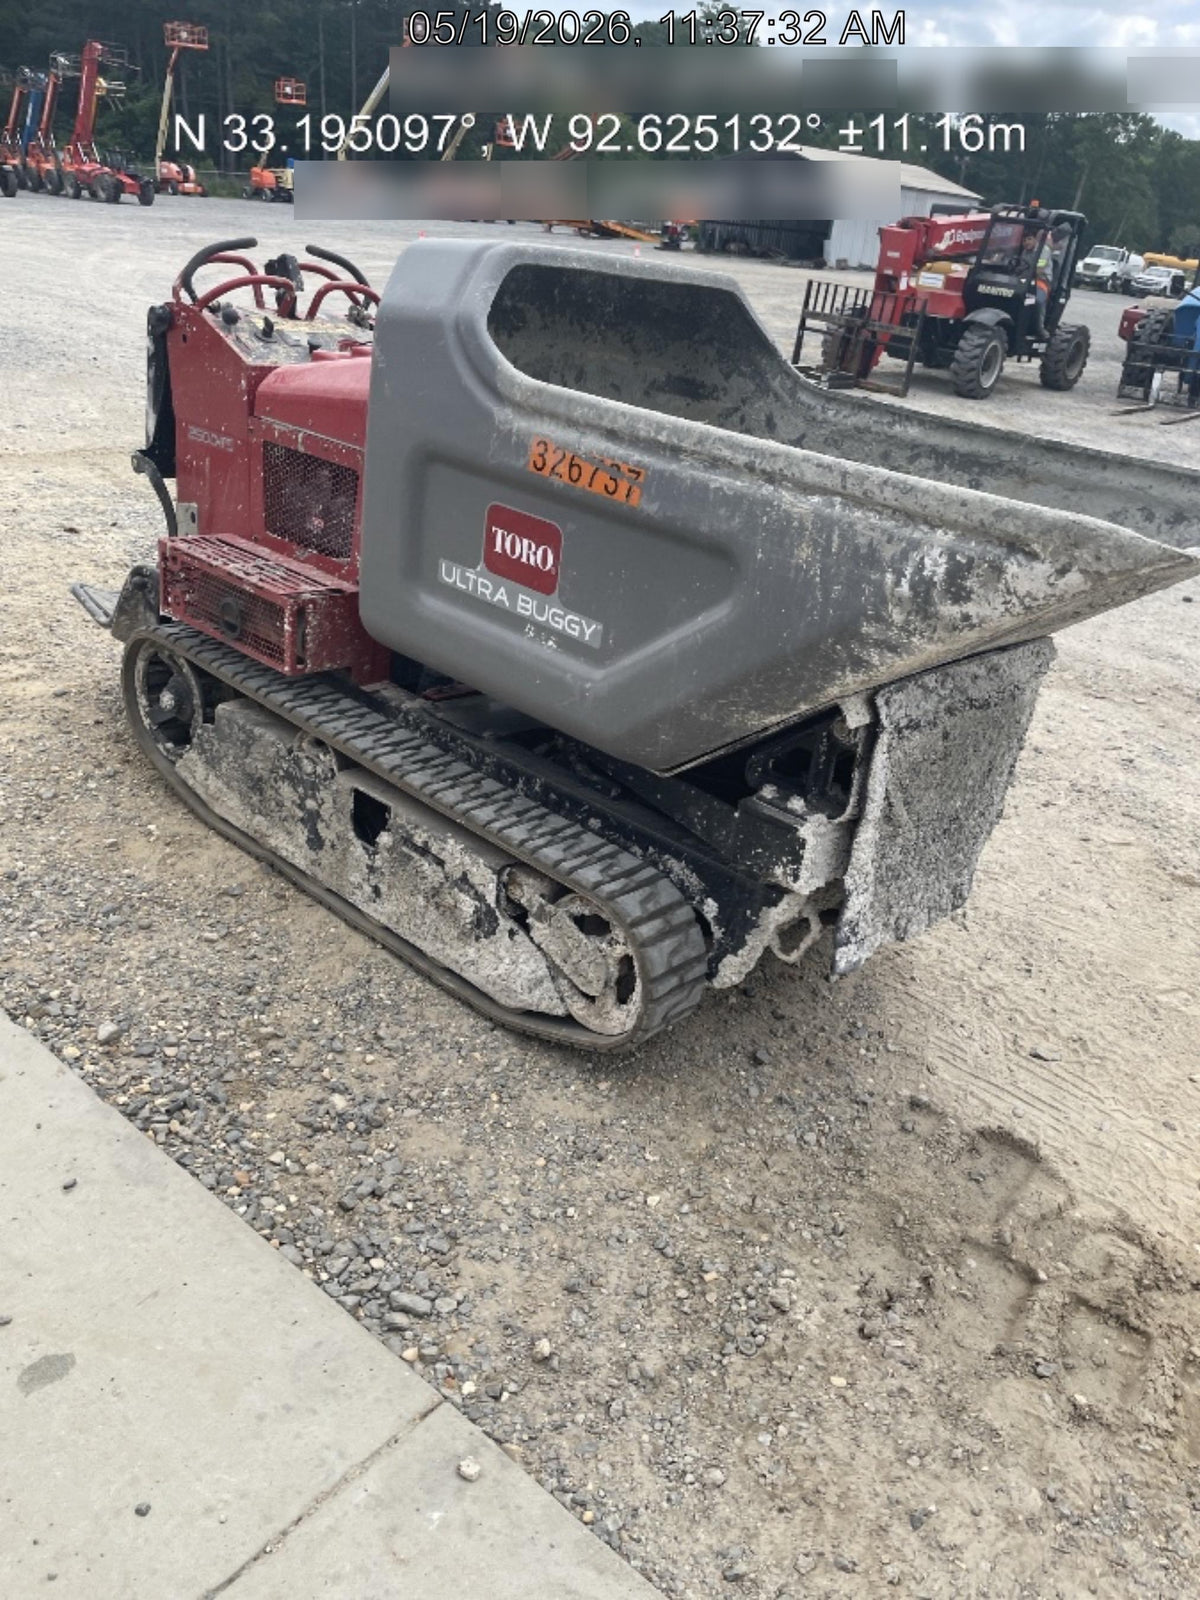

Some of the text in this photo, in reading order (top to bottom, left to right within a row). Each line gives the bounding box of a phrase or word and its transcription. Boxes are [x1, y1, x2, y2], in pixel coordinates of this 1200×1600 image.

[491, 526, 555, 572] TORO
[441, 562, 597, 641] ULTRA BUGGY
